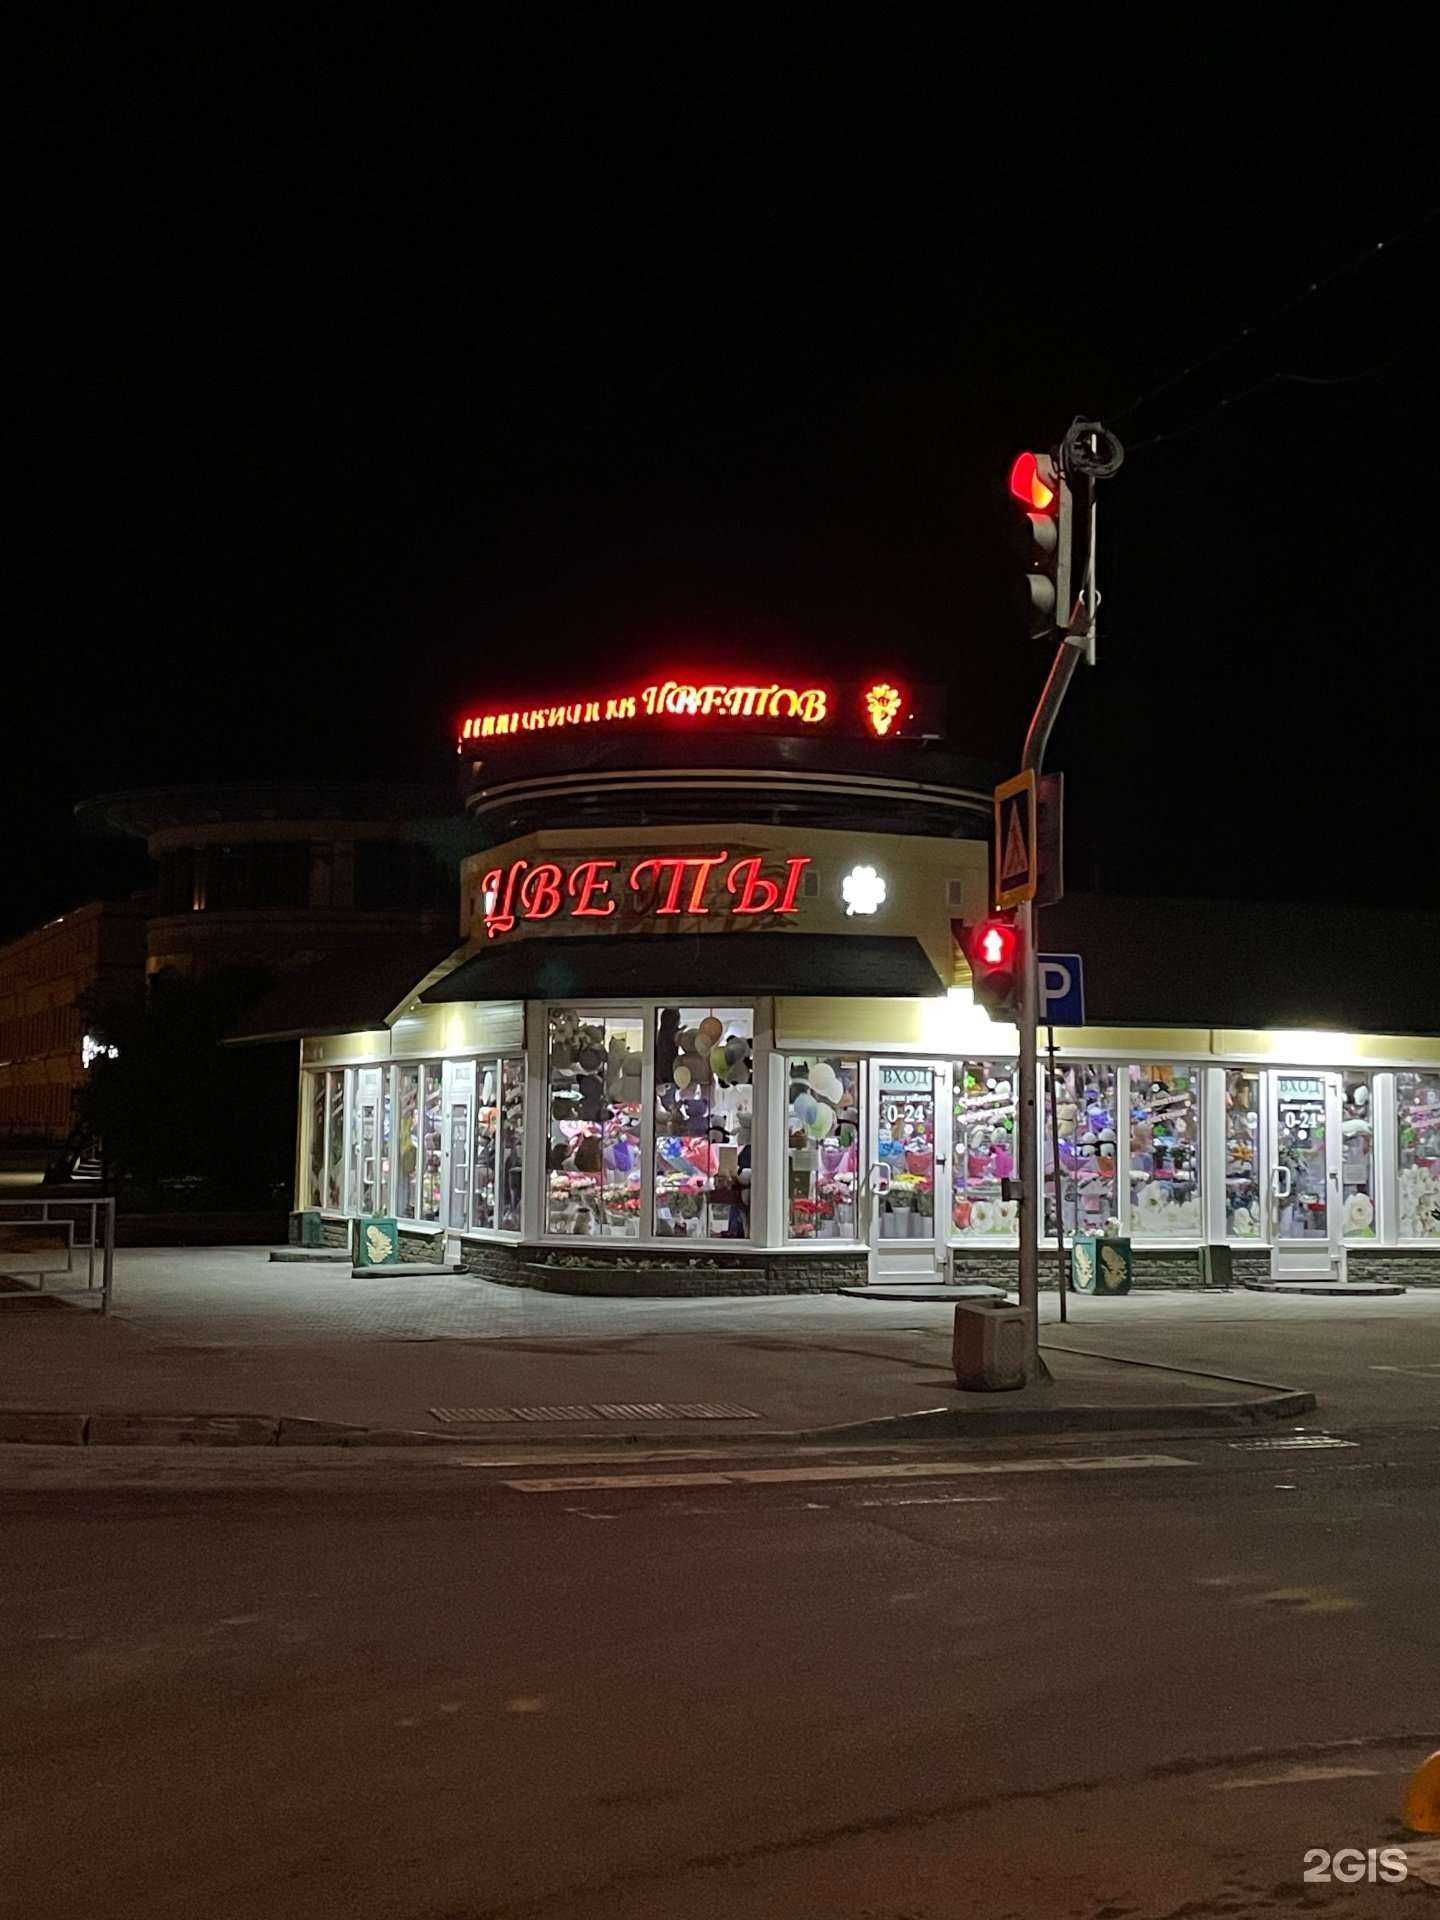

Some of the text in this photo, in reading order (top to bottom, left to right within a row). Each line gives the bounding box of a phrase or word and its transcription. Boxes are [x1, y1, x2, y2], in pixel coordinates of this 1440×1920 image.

[482, 851, 811, 938] ЦВЕТЫ
[883, 1069, 928, 1086] ВХОД
[887, 1104, 925, 1123] 0-24
